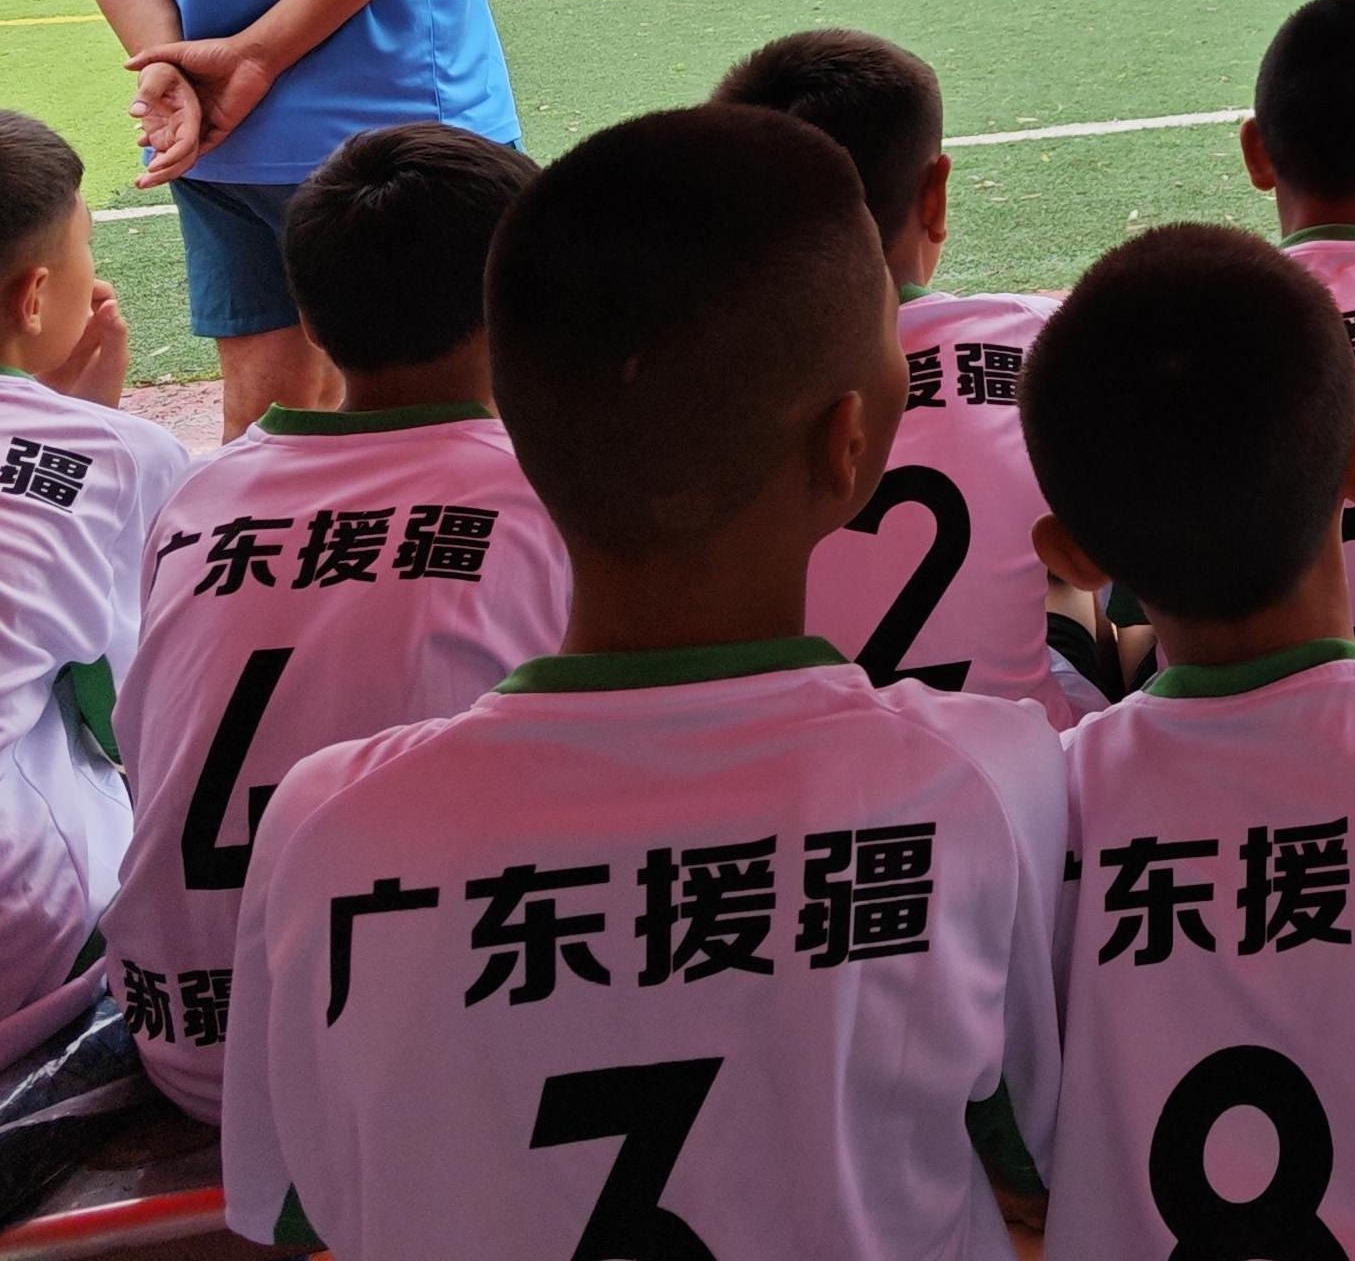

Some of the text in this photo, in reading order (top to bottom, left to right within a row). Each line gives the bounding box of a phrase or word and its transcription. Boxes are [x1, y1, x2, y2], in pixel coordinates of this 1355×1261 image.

[147, 504, 499, 597] 广东援疆
[326, 821, 937, 1029] 广东援疆
